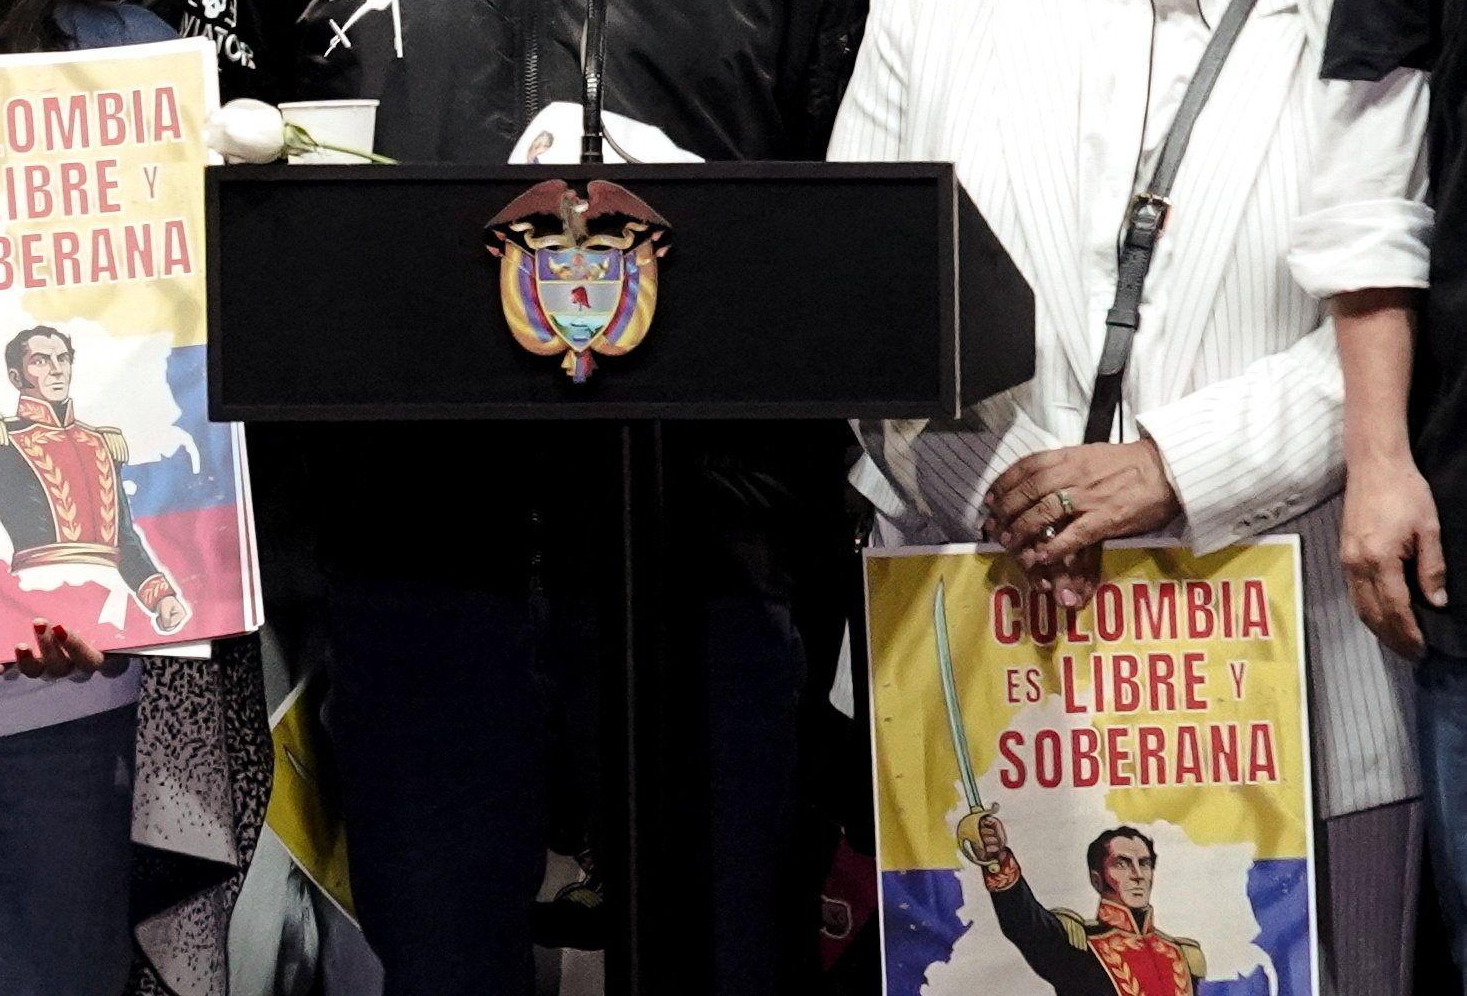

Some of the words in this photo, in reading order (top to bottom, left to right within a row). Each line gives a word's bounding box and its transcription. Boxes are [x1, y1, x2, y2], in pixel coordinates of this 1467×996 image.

[144, 166, 157, 198] Y
[993, 580, 1269, 644] COLOMBIA
[1007, 668, 1041, 704] ES
[1062, 653, 1208, 714] LIBRE
[1230, 662, 1245, 699] Y
[999, 723, 1277, 789] SOBERANA
